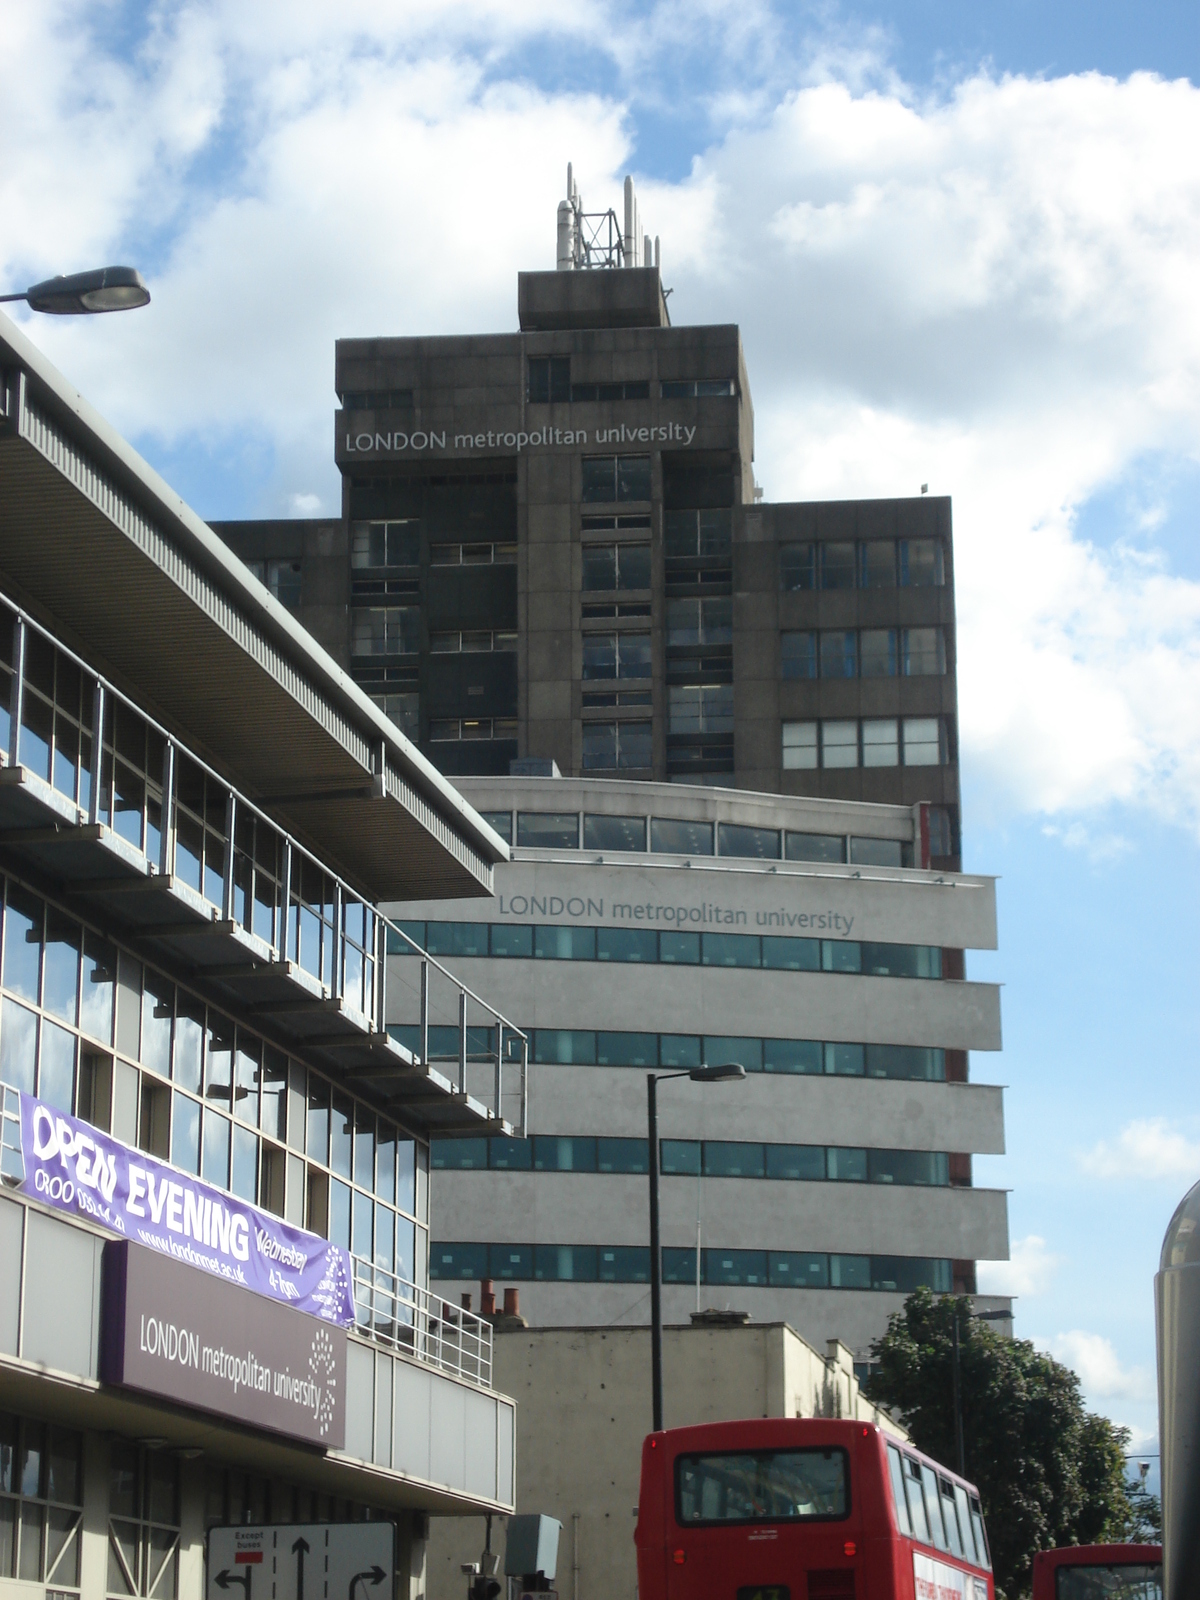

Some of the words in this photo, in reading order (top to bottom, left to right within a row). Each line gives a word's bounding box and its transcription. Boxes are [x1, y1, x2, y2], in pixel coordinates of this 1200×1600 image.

[345, 431, 447, 452] LONDON
[454, 426, 588, 451] metropolitan
[595, 421, 697, 446] university
[499, 895, 604, 918] LONDON
[612, 902, 748, 928] metropolitan
[755, 907, 855, 936] university
[32, 1105, 118, 1203] OPEN
[126, 1163, 250, 1261] EVENING
[137, 1228, 248, 1285] www.londonmet.ac.uk
[254, 1226, 308, 1275] Wednesday
[269, 1268, 300, 1299] 4-7pm
[140, 1314, 200, 1370] LONDON
[202, 1345, 271, 1393] metropolitan
[273, 1367, 322, 1420] university
[235, 1531, 264, 1540] Except
[237, 1541, 261, 1549] buses
